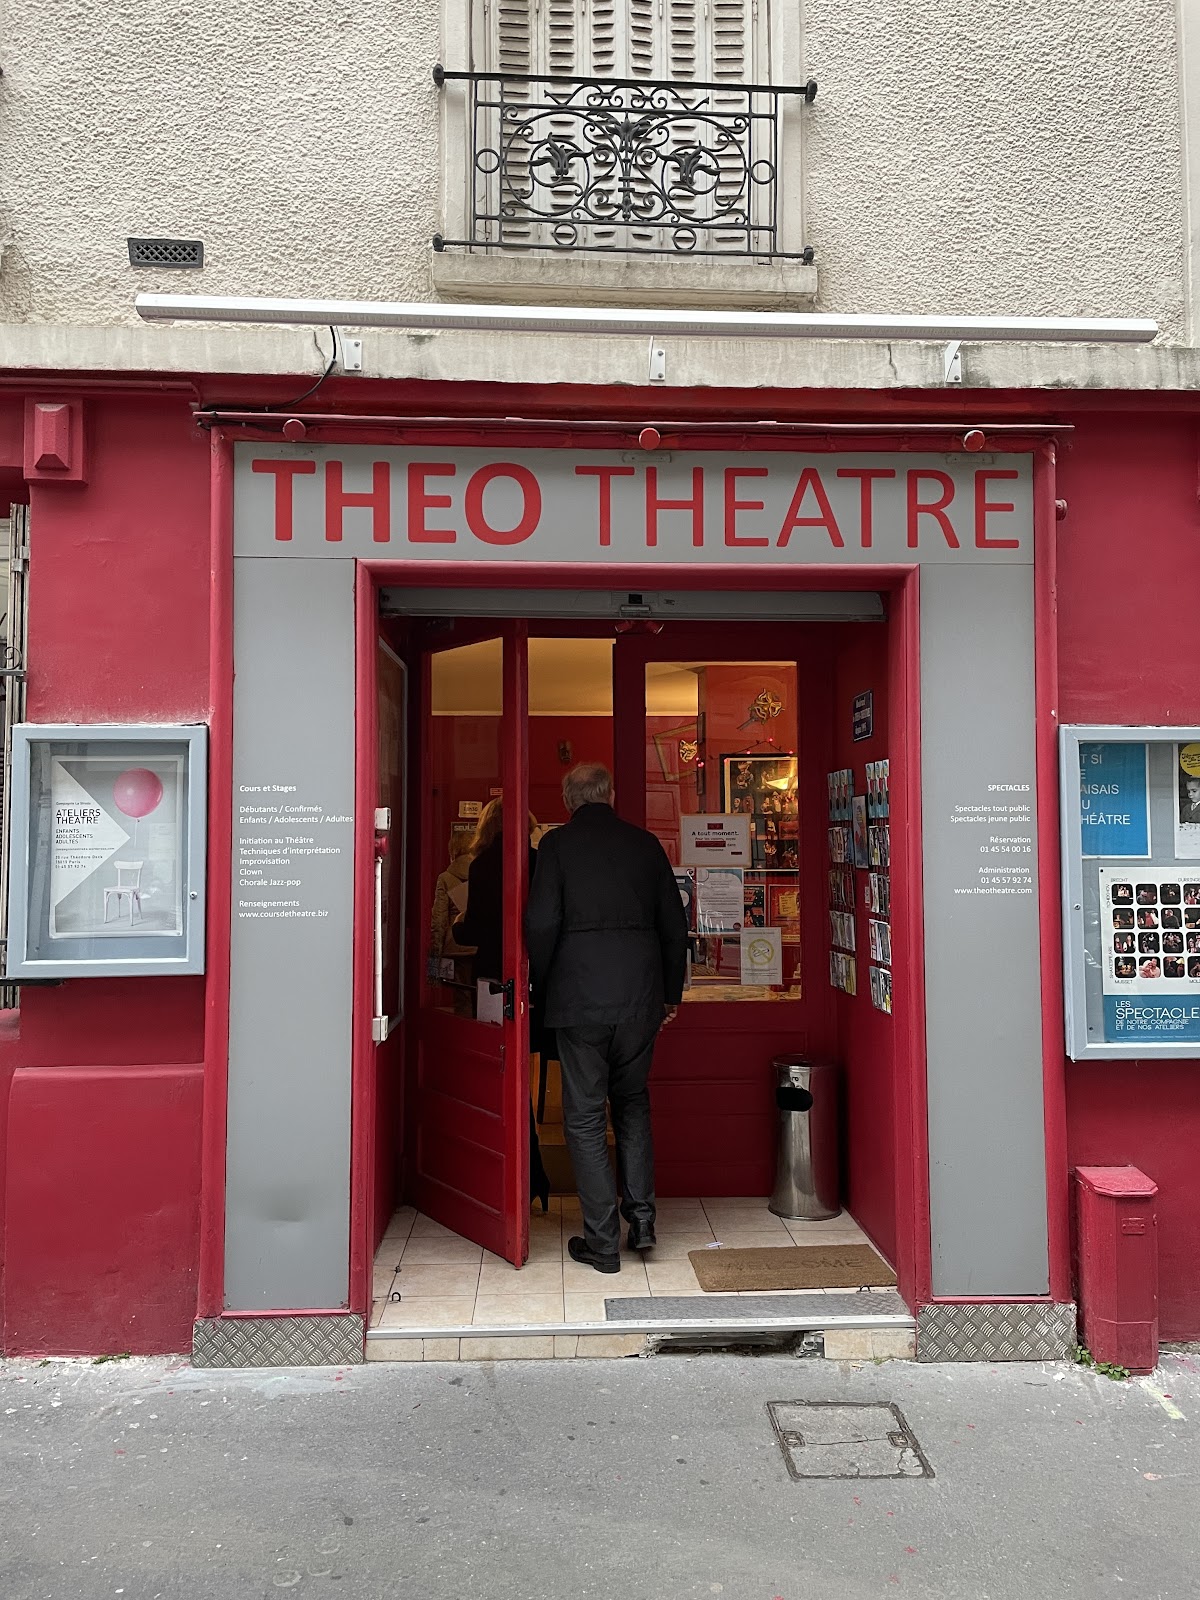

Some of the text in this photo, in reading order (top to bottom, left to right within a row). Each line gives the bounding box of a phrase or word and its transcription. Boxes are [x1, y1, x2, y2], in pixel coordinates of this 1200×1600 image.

[252, 459, 1020, 548] THEO THEATRE
[1091, 754, 1102, 764] SI
[273, 785, 296, 793] Stages
[1080, 784, 1119, 794] AISAIS
[240, 816, 267, 824] Enfants
[268, 816, 272, 824] /
[1081, 812, 1131, 825] HÉÂTRE
[240, 848, 280, 856] Techniques
[240, 858, 290, 866] Improvisation
[269, 879, 301, 887] Jazz-pop
[240, 900, 300, 908] Renseignements
[239, 910, 328, 918] www.coursdetheatre.biz
[1116, 1008, 1199, 1019] SPECTACLE
